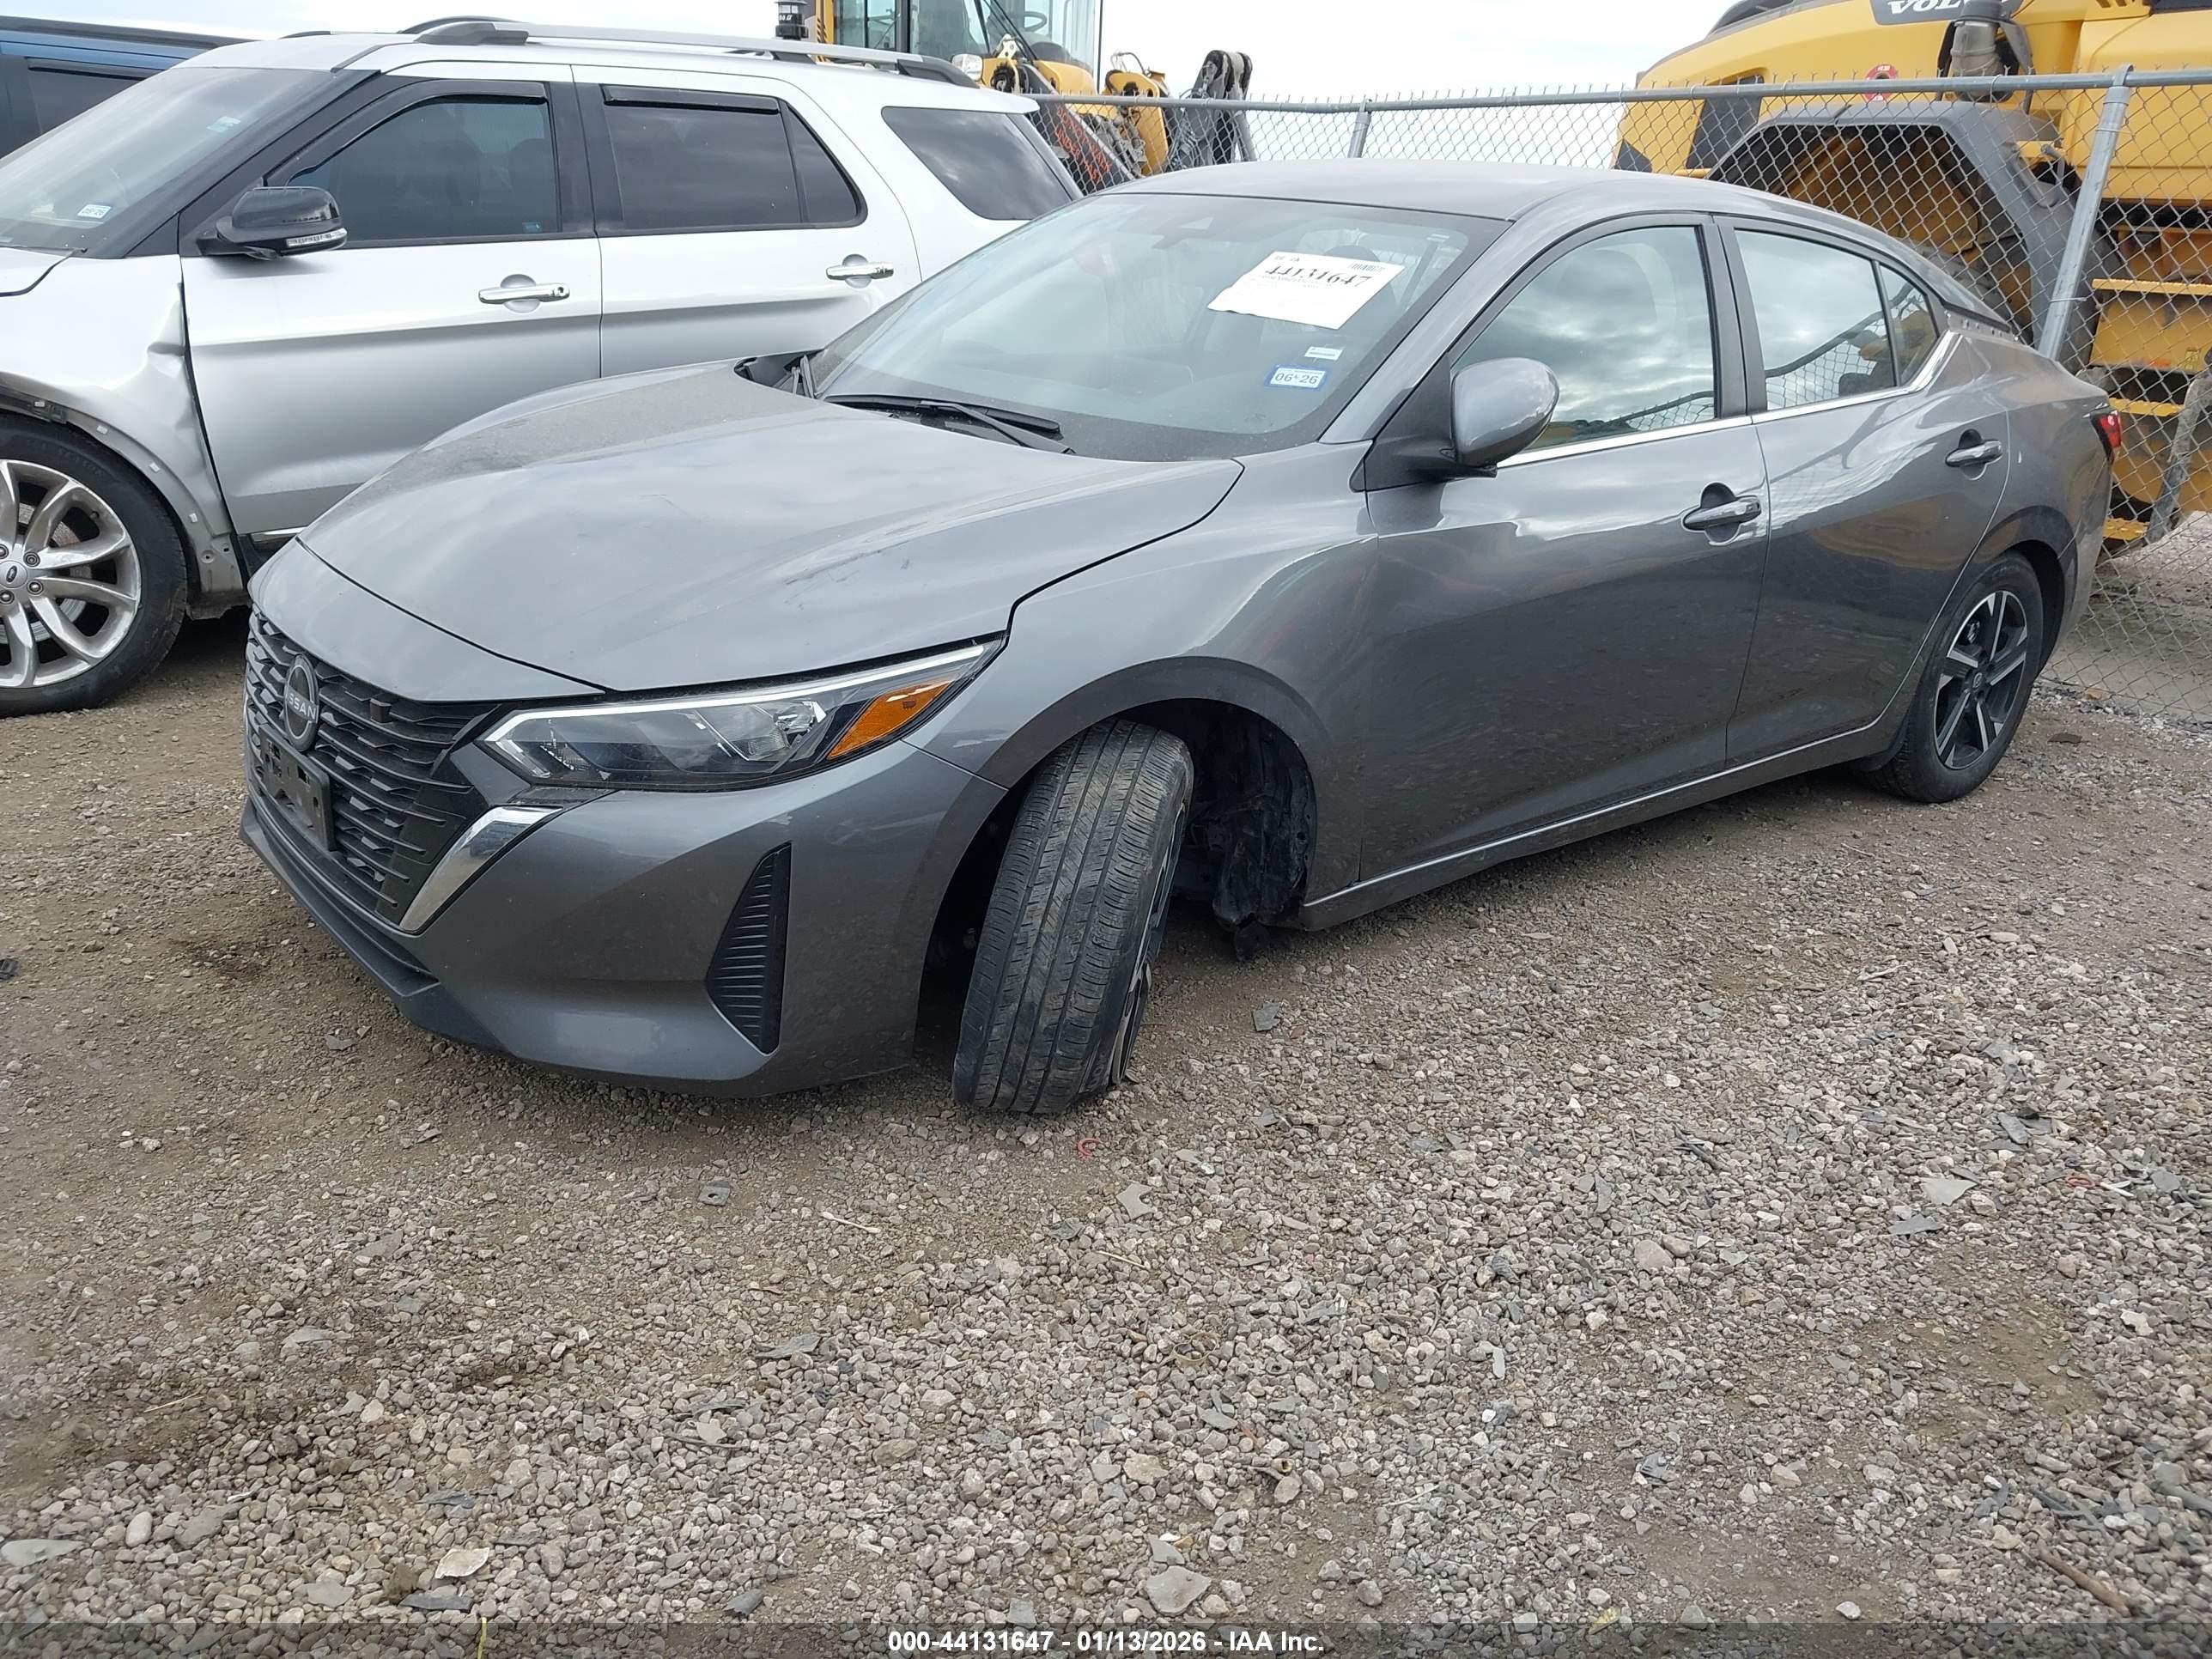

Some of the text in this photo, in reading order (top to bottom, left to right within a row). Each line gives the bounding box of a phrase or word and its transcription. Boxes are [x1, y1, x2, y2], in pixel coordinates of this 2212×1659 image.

[1887, 0, 1972, 14] VOL
[1265, 265, 1372, 287] 44131647
[1298, 374, 1319, 385] 26
[287, 691, 317, 720] SSAN
